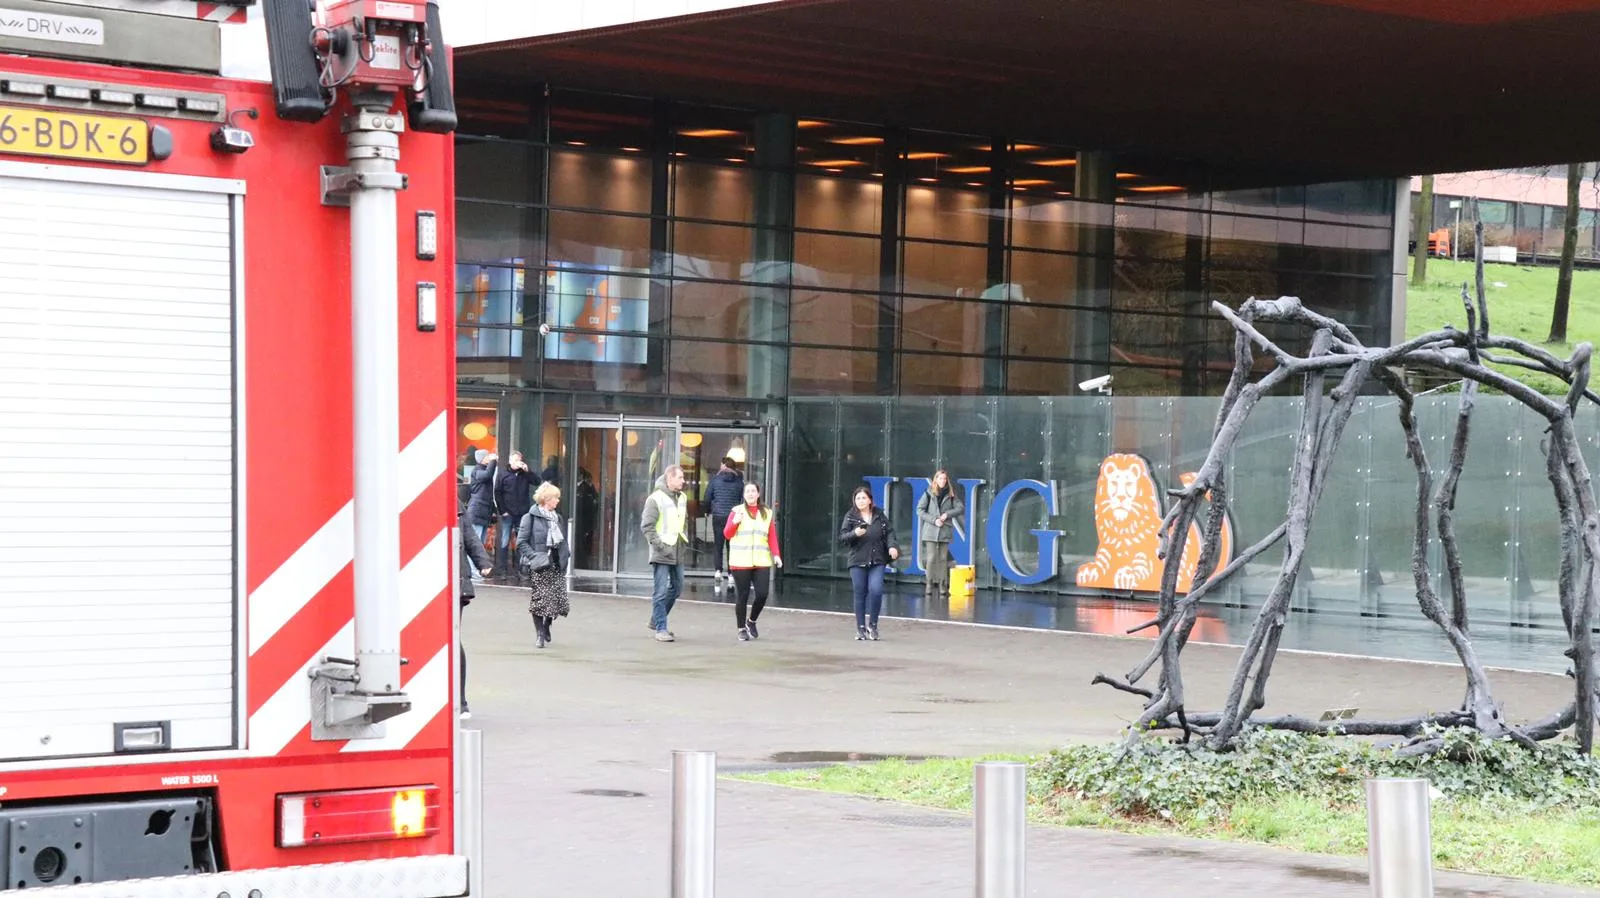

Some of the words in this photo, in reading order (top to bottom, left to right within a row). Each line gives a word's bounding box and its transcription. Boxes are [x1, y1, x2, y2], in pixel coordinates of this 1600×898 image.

[26, 17, 63, 35] DRV
[161, 776, 190, 785] WATER
[192, 775, 212, 784] 1500
[213, 774, 220, 784] L
